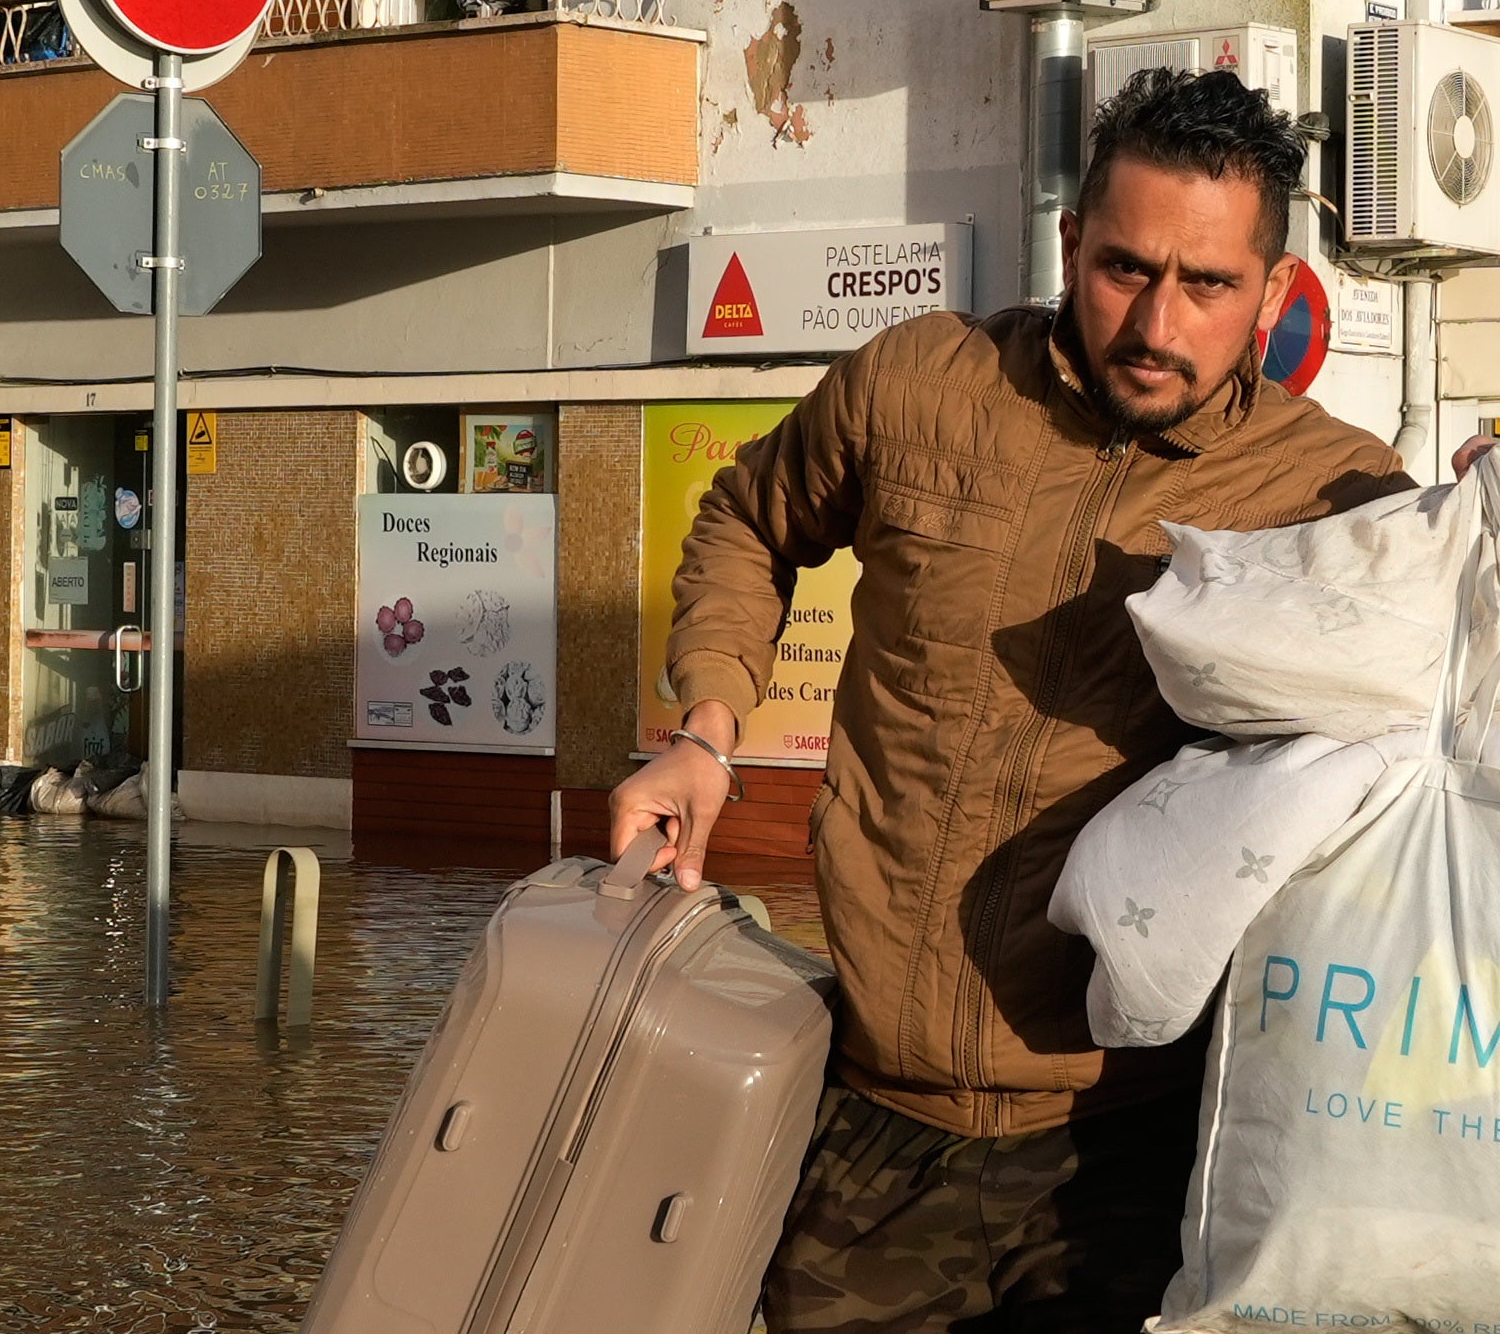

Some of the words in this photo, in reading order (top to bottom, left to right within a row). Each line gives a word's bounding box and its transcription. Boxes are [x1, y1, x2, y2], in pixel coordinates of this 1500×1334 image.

[80, 164, 126, 180] CMAS
[208, 162, 229, 180] AT
[826, 241, 942, 268] PASTELARIA
[827, 268, 941, 298] CRESPO'S
[802, 306, 839, 331] PÃO
[846, 304, 940, 333] QUNENT
[86, 392, 96, 407] 17
[382, 512, 431, 533] Doces
[416, 541, 498, 568] Regionais
[51, 576, 85, 588] ABERTO
[780, 642, 842, 663] Bifanas
[764, 681, 794, 701] des
[1305, 1088, 1403, 1129] LOVE
